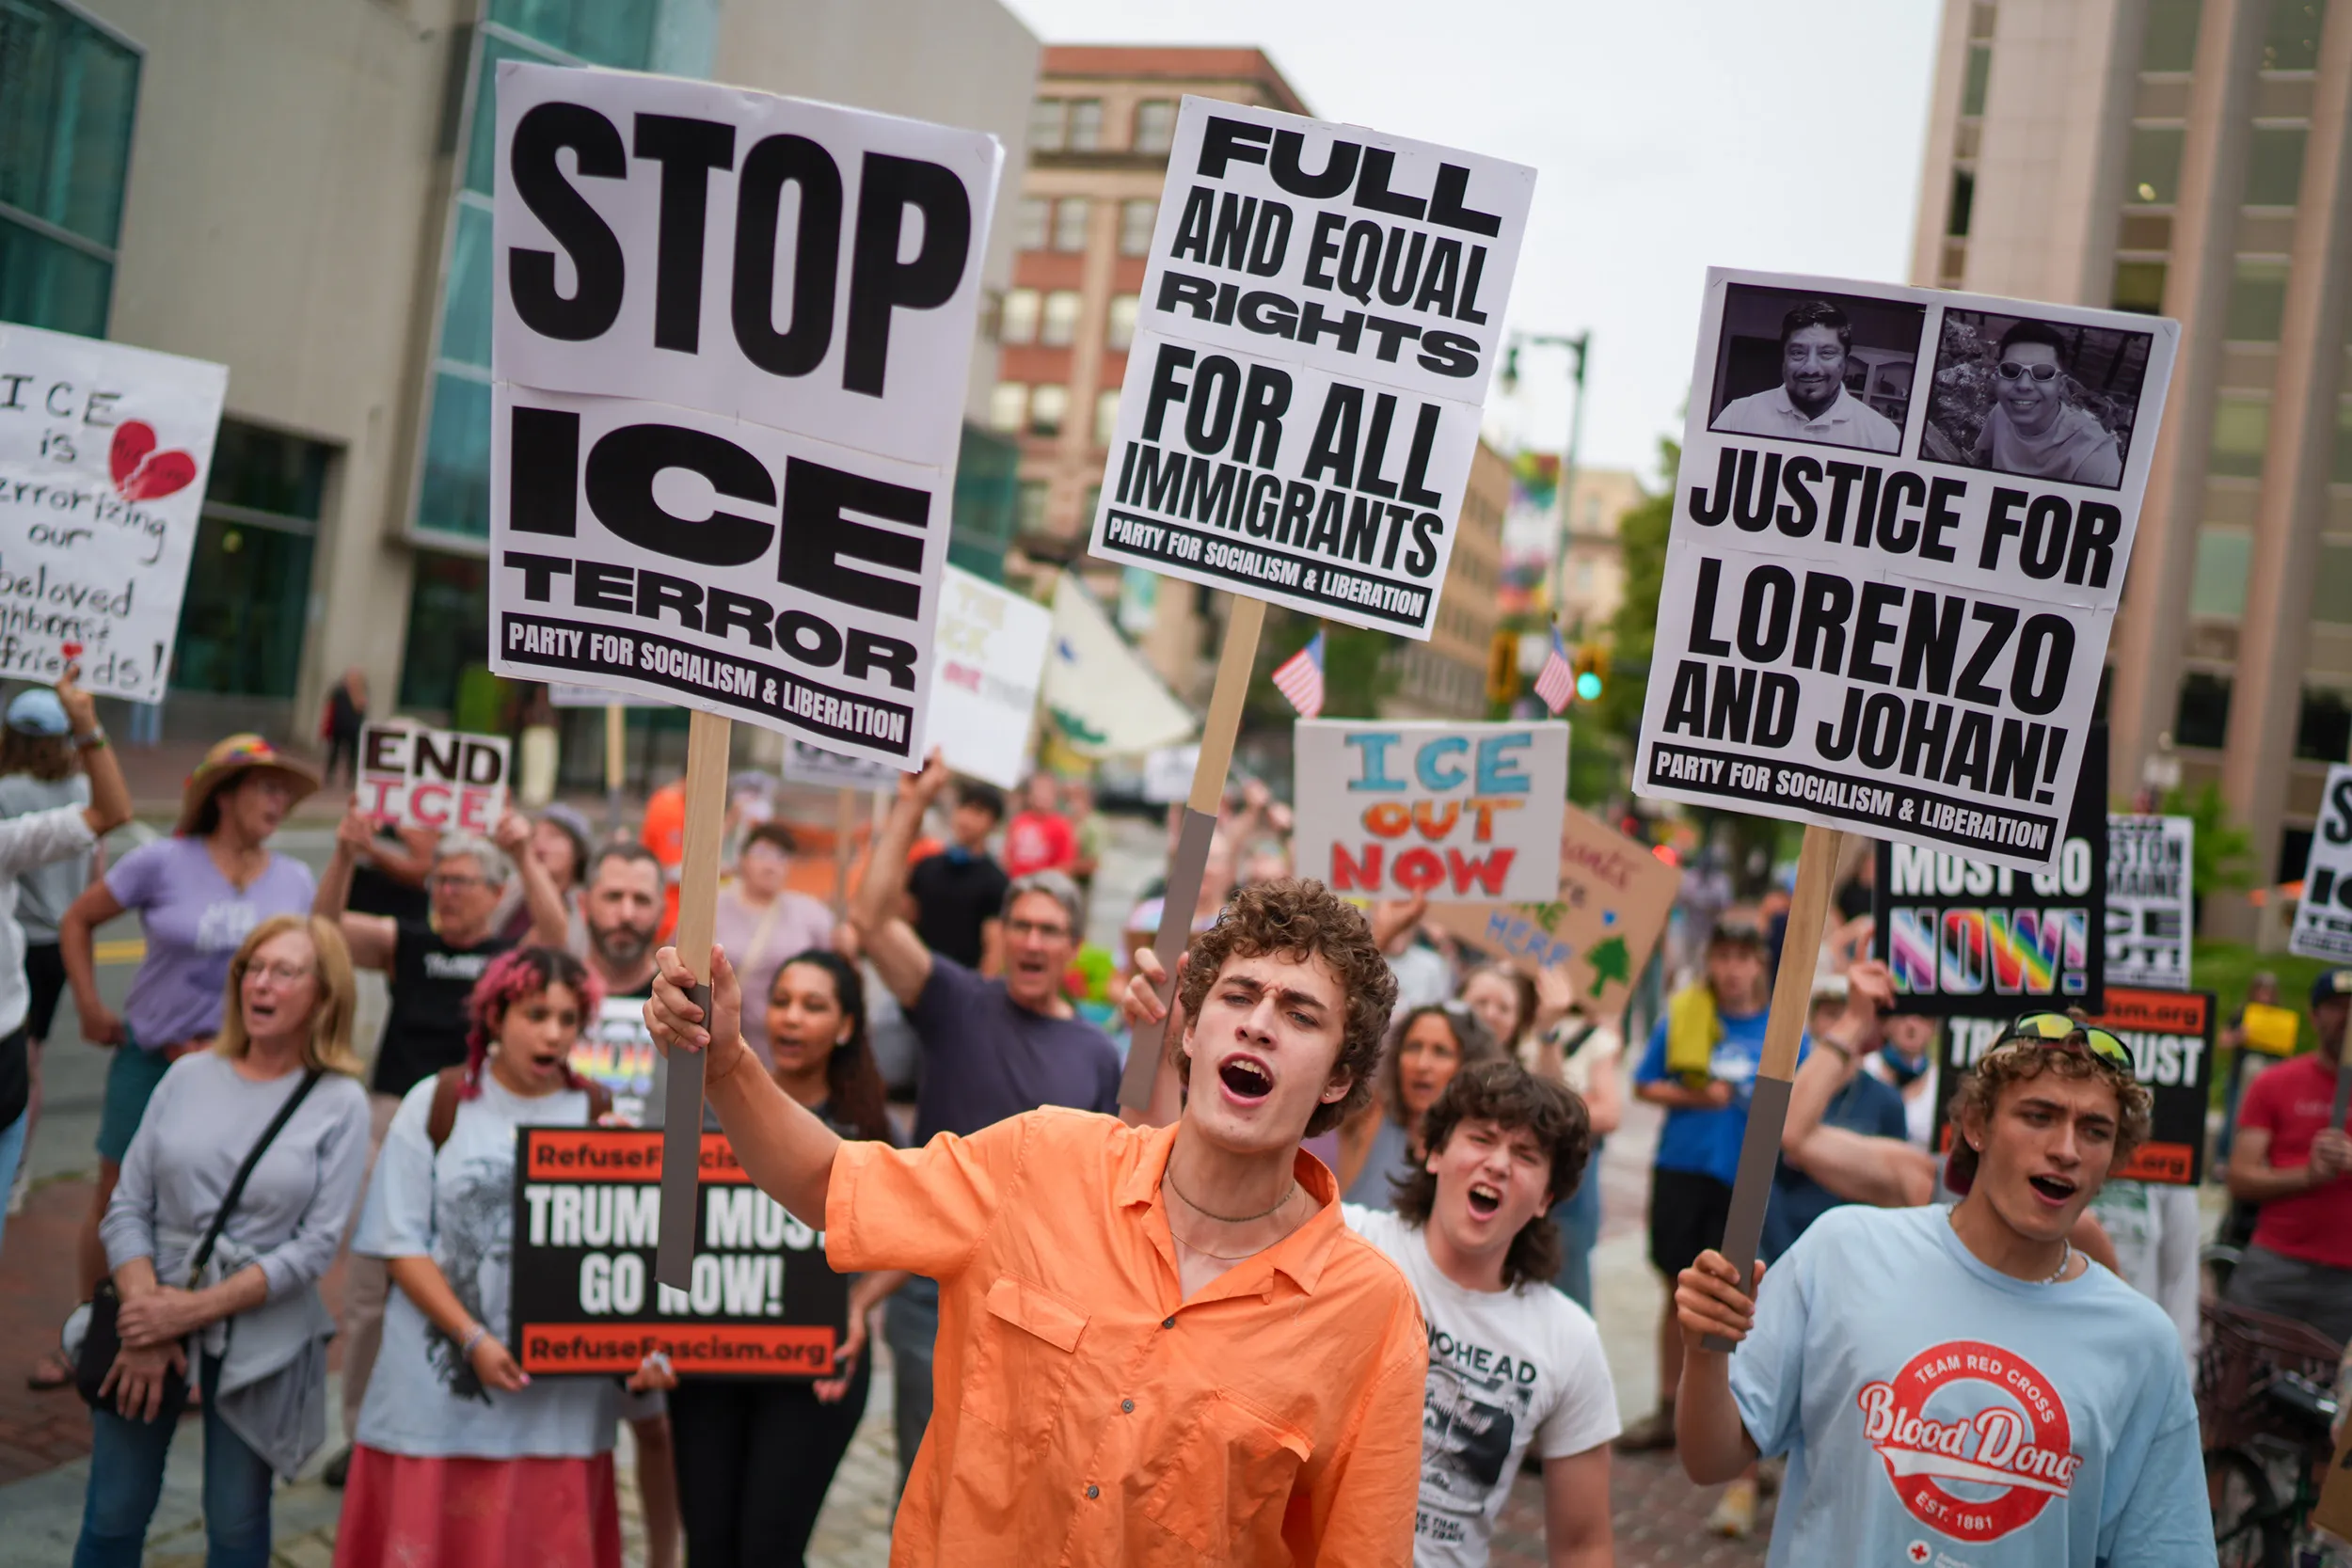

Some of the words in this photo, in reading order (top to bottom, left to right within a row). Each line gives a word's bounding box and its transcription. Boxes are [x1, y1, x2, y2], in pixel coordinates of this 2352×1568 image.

[1196, 115, 1502, 239] FULL
[509, 101, 971, 399] STOP
[1170, 184, 1294, 278] AND
[1302, 210, 1487, 325] EQUAL
[1155, 270, 1481, 378] RIGHTS
[0, 372, 121, 428] ICE
[1141, 342, 1294, 470] FOR
[1304, 381, 1442, 509] ALL
[40, 427, 77, 464] is
[27, 521, 92, 549] our
[509, 404, 931, 621] ICE
[1115, 440, 1444, 578] IMMIGRANTS
[1689, 447, 1966, 563] JUSTICE
[1979, 485, 2122, 590] FOR
[1108, 518, 1165, 551] PARTY
[1167, 531, 1204, 562] FOR
[1205, 541, 1300, 587] SOCIALISM
[1302, 568, 1316, 591] &
[1321, 571, 1425, 617] LIBERATION
[503, 550, 919, 691] TERROR
[1688, 556, 2076, 716] LORENZO
[509, 622, 582, 658] PARTY
[590, 632, 634, 666] FOR
[641, 641, 756, 699] SOCIALISM
[762, 676, 779, 705] &
[783, 681, 906, 745] LIBERATION
[368, 731, 502, 784] END
[1345, 731, 1533, 795] ICE
[1662, 658, 1801, 749] AND
[1815, 688, 2070, 806] JOHAN!
[365, 780, 492, 832] ICE
[1361, 798, 1525, 842] OUT
[1655, 751, 1724, 784] PARTY
[1728, 761, 1771, 793] FOR
[1775, 770, 1894, 818] SOCIALISM
[1898, 797, 1915, 821] &
[1921, 802, 2050, 851] LIBERATION
[1330, 840, 1518, 895] NOW
[1888, 907, 2090, 995] NOW!
[2119, 1030, 2206, 1088] UST
[524, 1184, 660, 1247] TRUM
[706, 1185, 824, 1252] MUS
[580, 1251, 646, 1317] GO
[1859, 1383, 1970, 1457] Blood
[1915, 1354, 1961, 1385] TEAM
[1967, 1354, 2002, 1375] RED
[2007, 1368, 2056, 1424] CROSS
[1915, 1491, 1948, 1522] EST.
[1956, 1513, 1993, 1530] 1881
